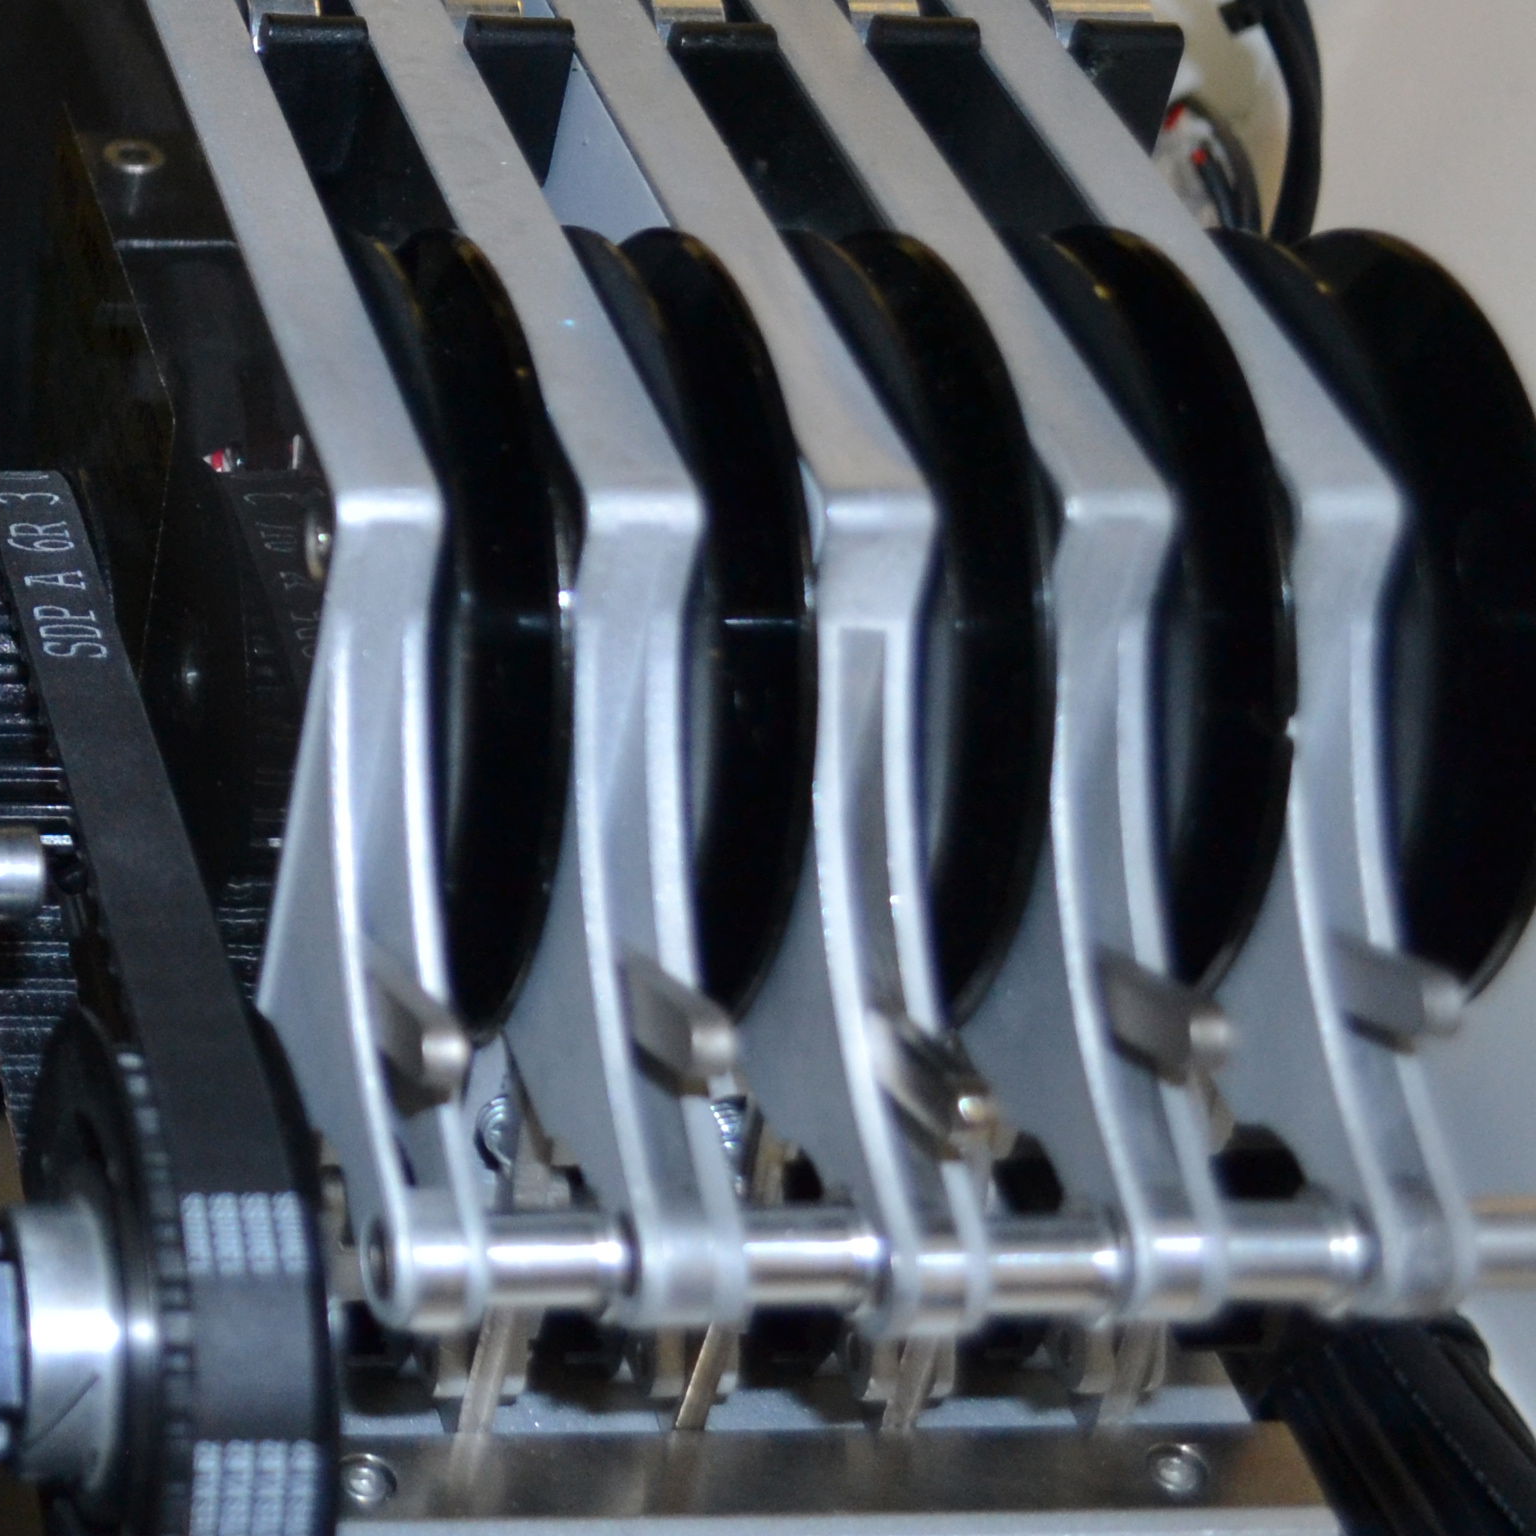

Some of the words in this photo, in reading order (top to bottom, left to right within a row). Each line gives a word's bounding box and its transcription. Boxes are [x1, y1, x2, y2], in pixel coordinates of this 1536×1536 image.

[7, 520, 76, 552] 6R
[23, 570, 87, 590] A
[33, 605, 109, 659] SDP
